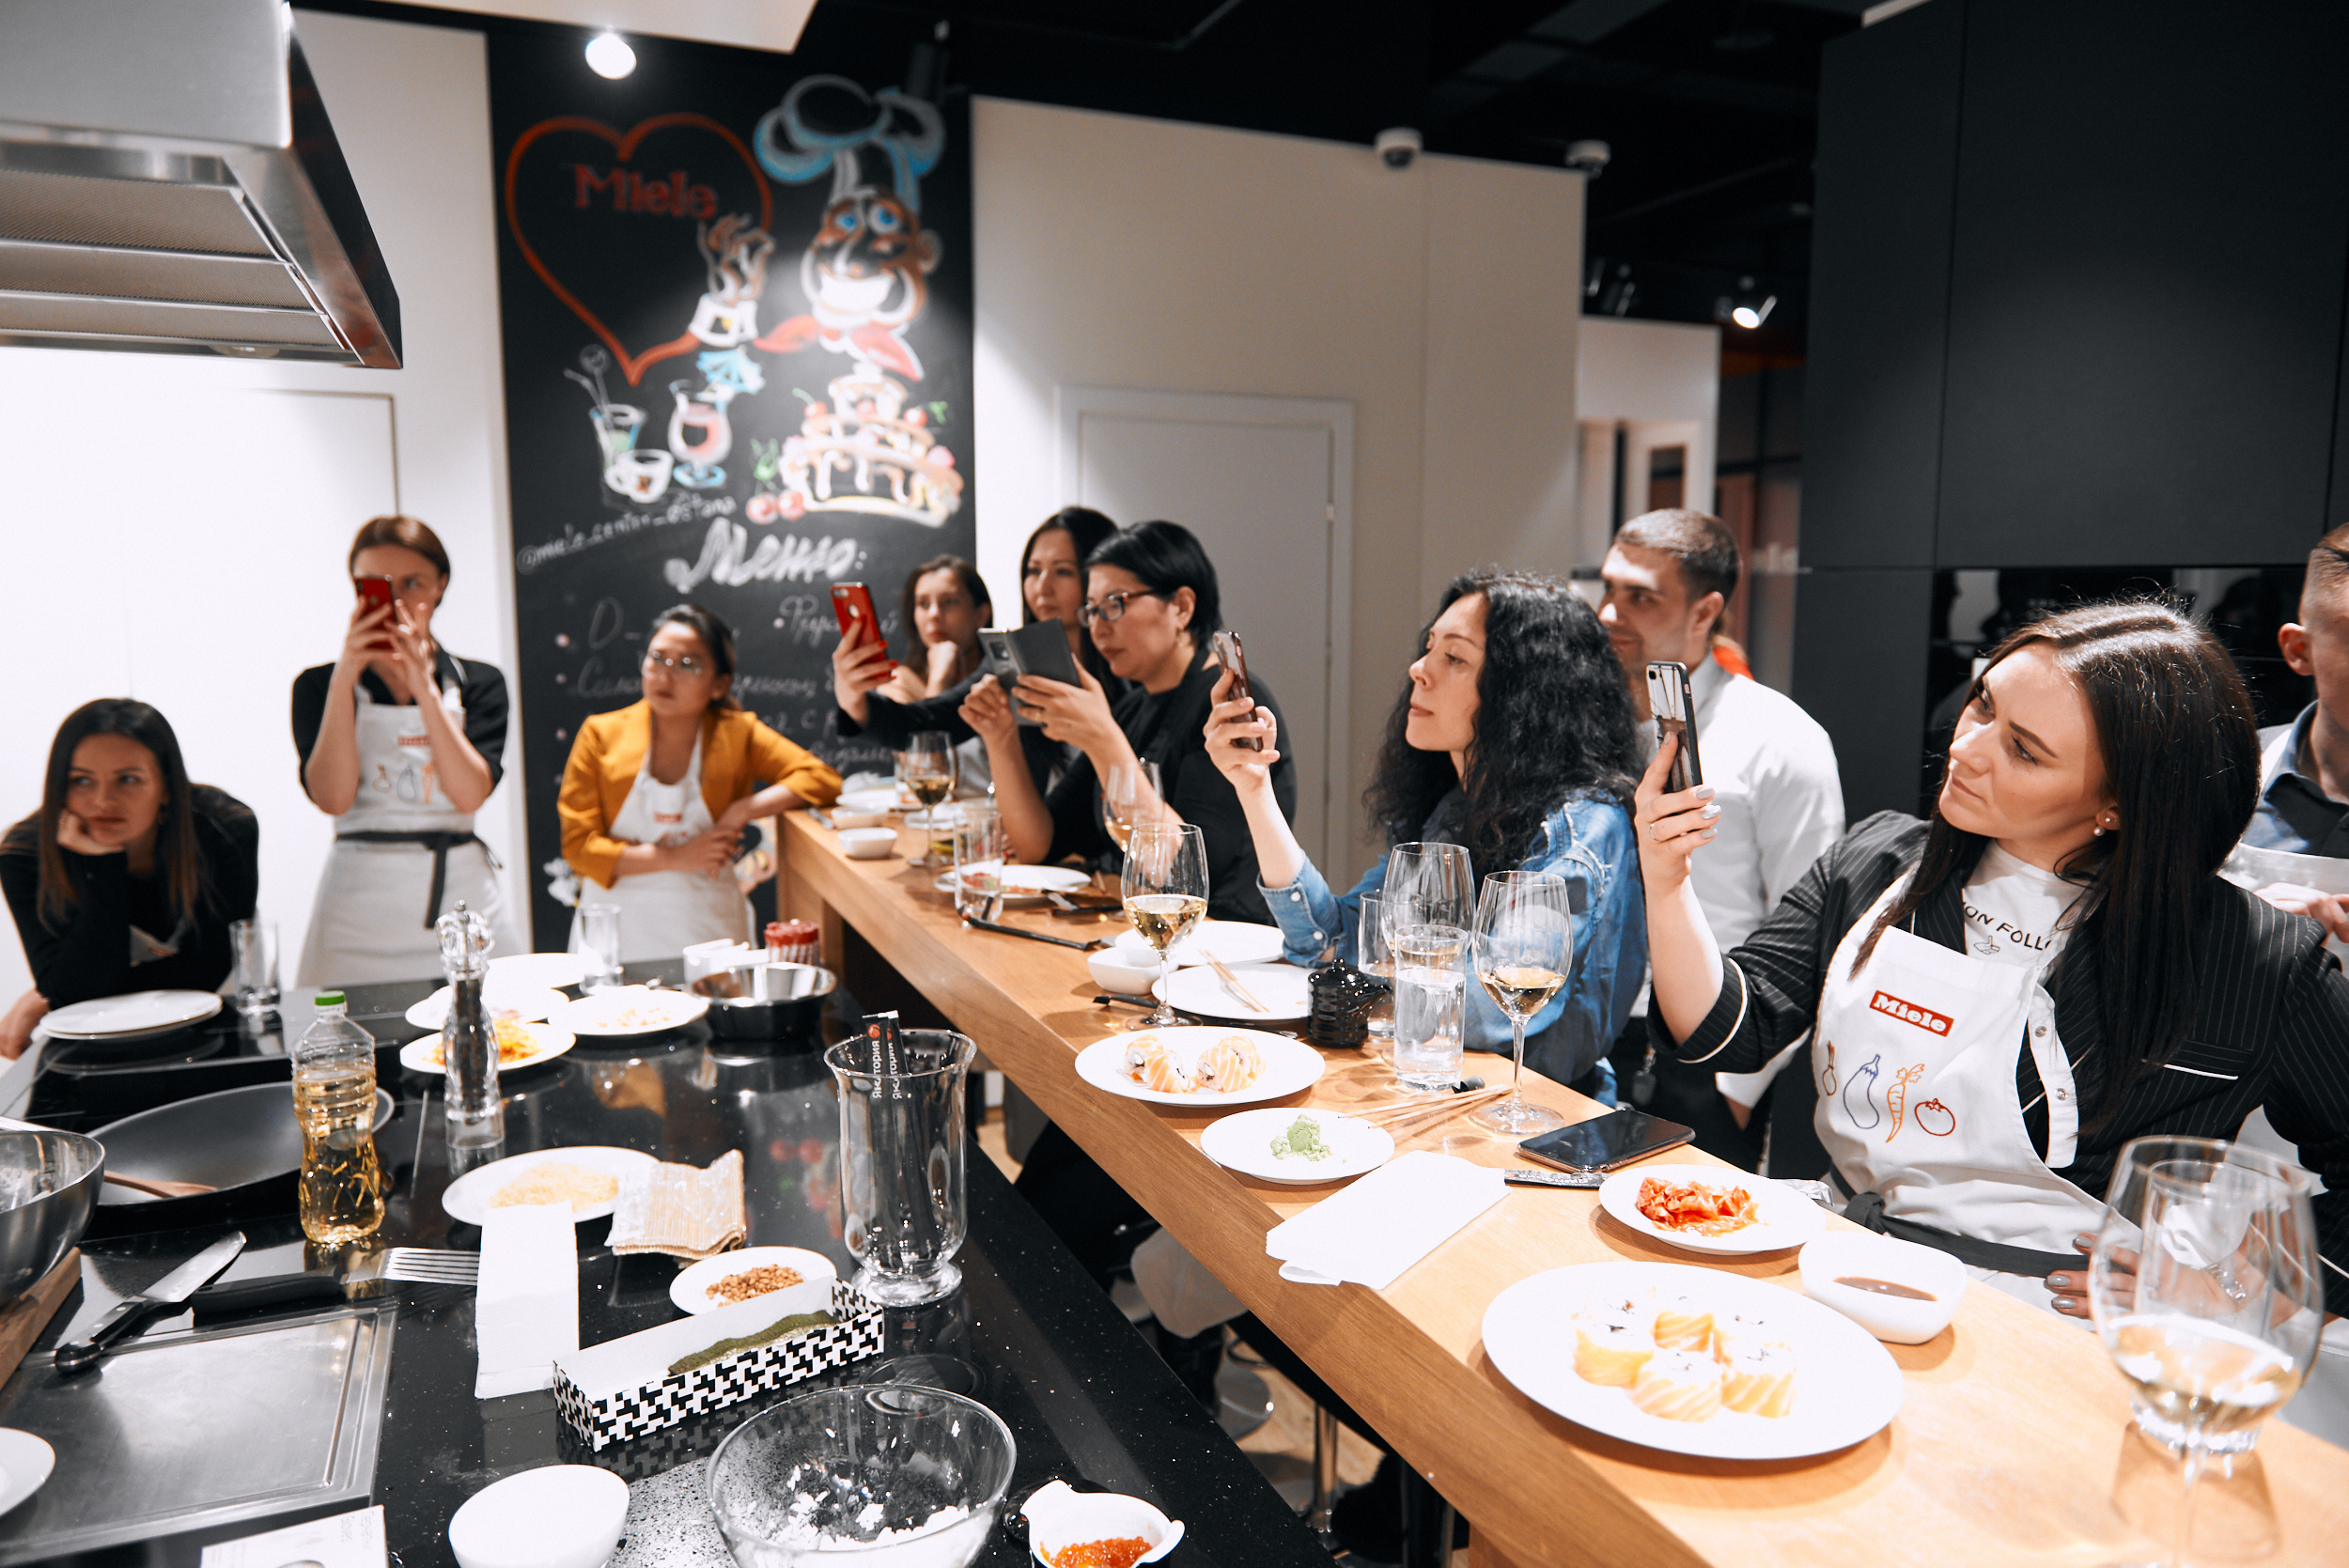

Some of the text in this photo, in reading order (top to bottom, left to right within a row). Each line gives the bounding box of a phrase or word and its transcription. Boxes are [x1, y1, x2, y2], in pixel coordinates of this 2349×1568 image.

[574, 163, 718, 220] Miele
[1963, 901, 1995, 925] ON
[1873, 993, 1947, 1032] Miele
